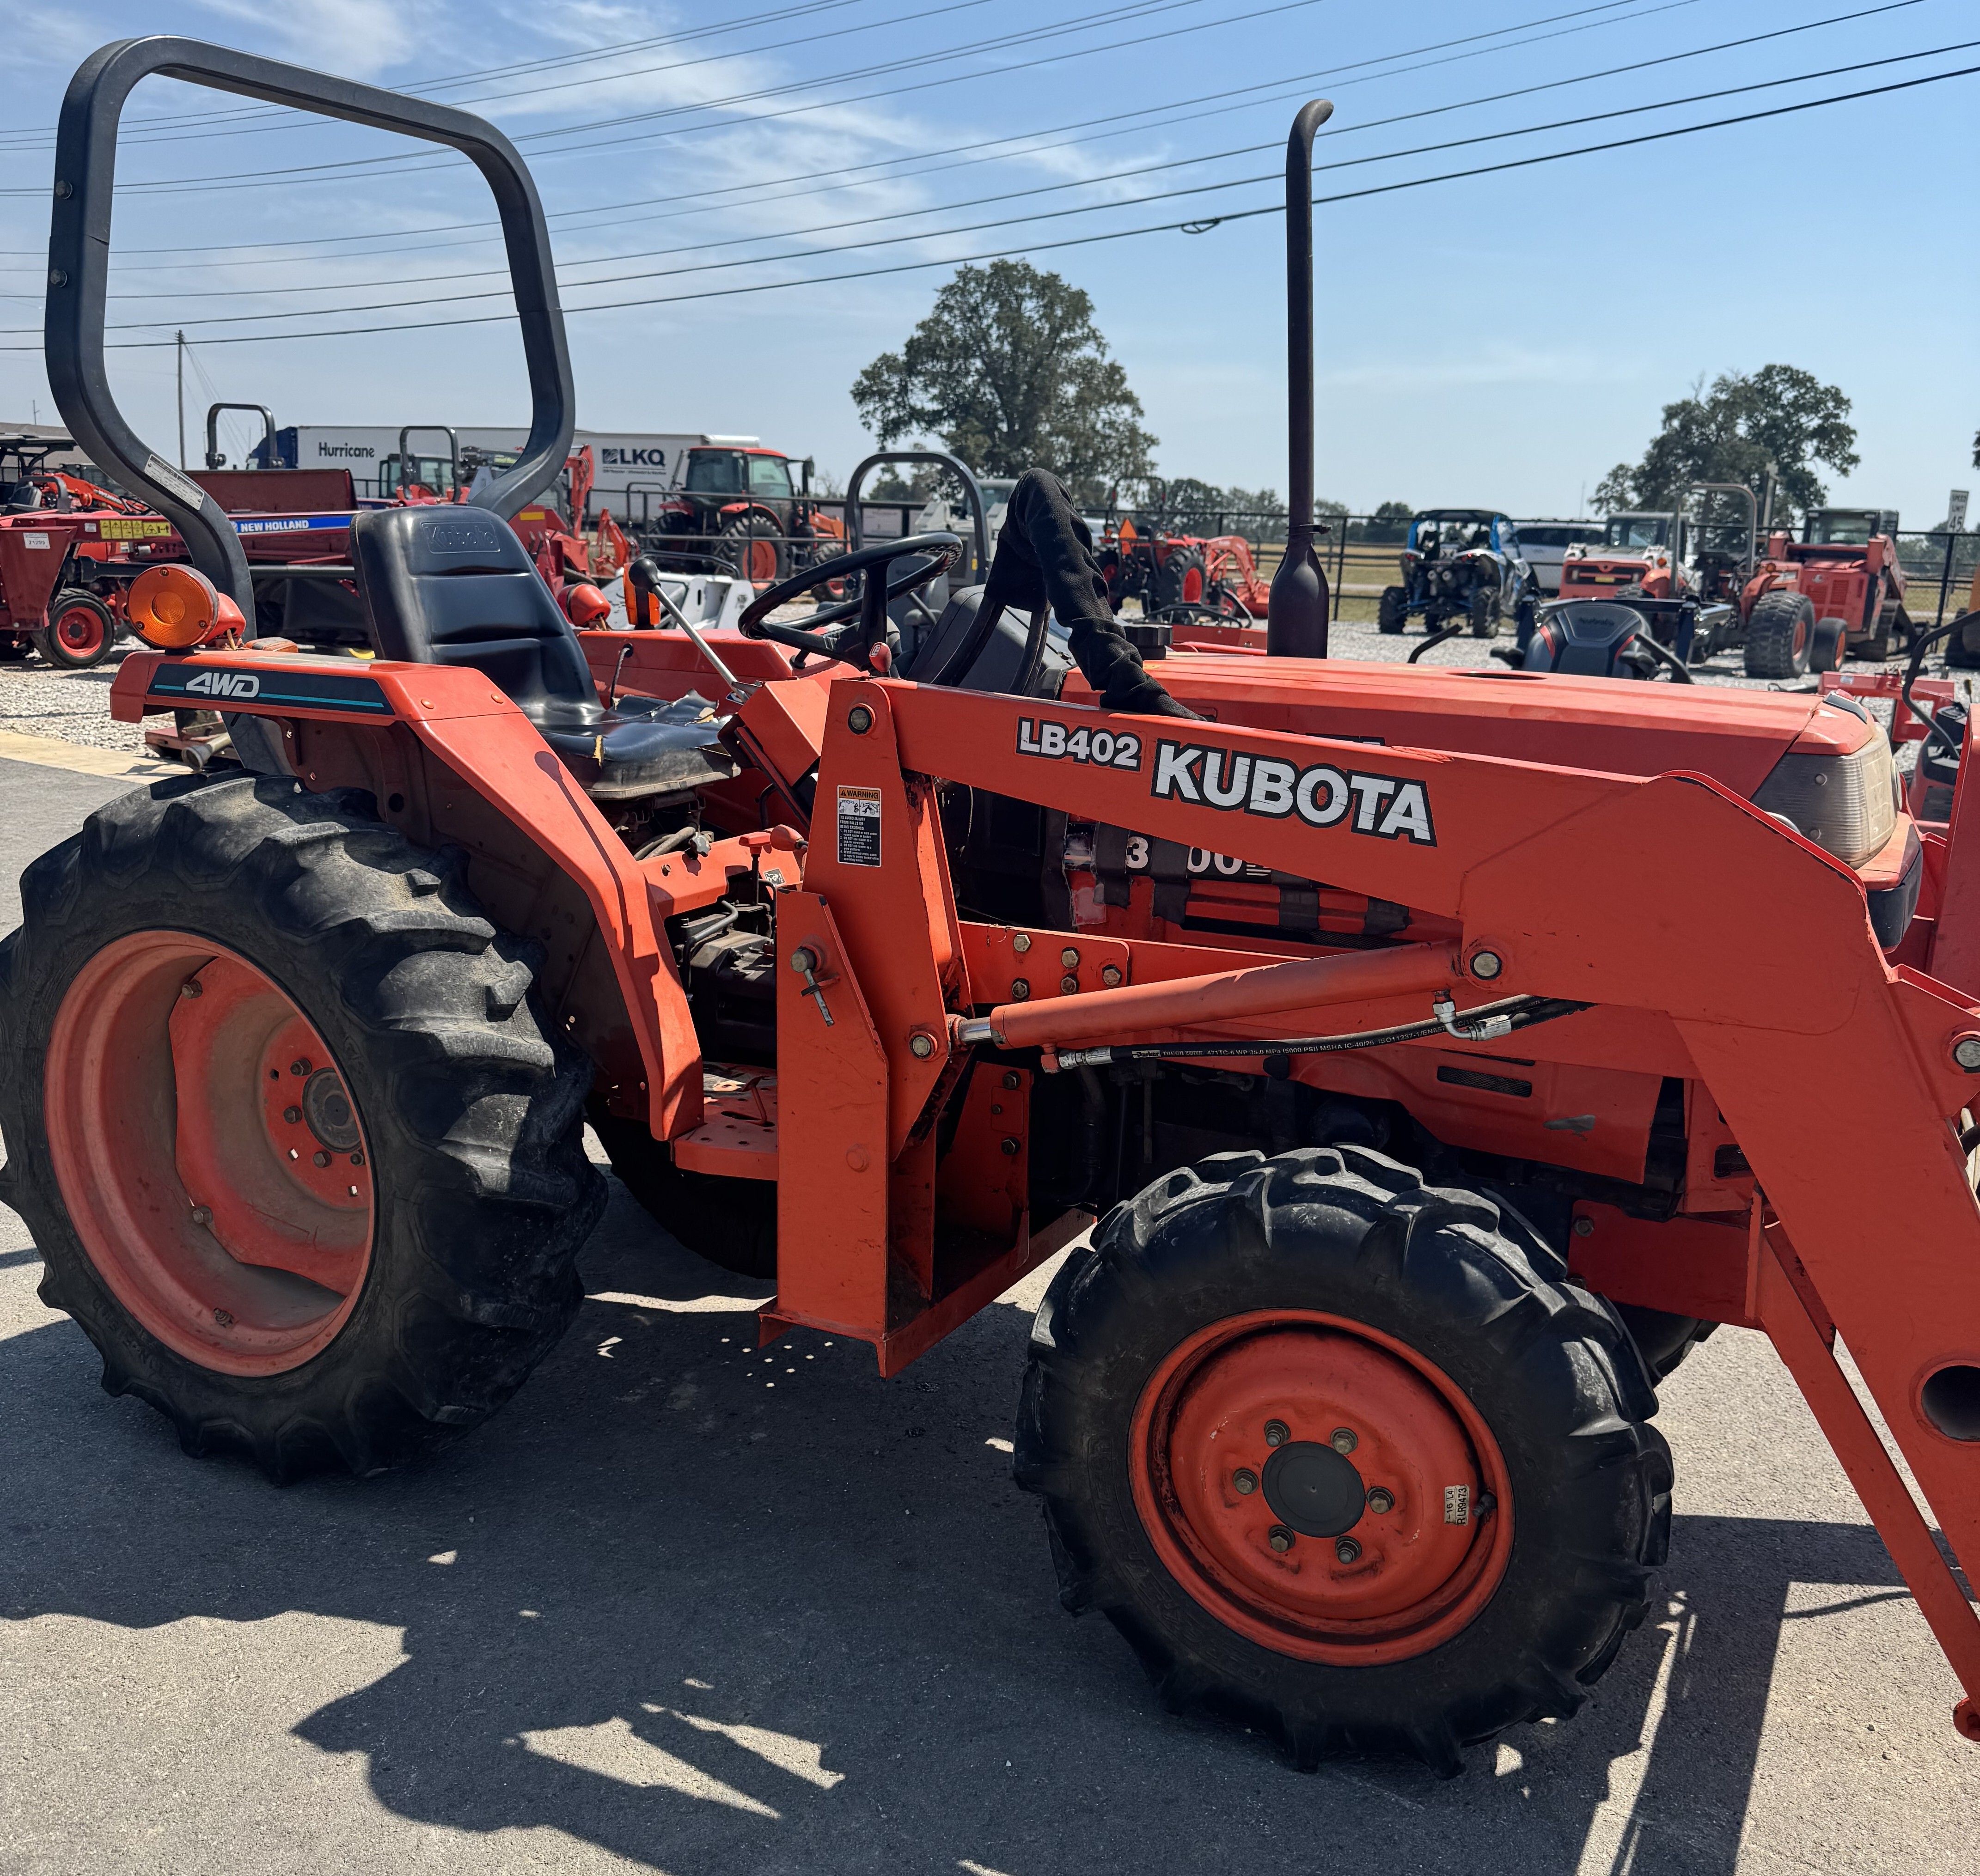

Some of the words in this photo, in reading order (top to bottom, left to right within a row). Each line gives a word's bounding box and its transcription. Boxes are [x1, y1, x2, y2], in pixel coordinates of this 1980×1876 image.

[319, 442, 375, 458] Hurricane
[620, 449, 665, 467] LKQ
[240, 522, 263, 532] NEW
[265, 520, 309, 531] HOLLAND
[1949, 516, 1963, 533] 45
[186, 672, 260, 698] 4WD
[1018, 719, 1140, 769] LB402
[847, 790, 878, 799] WARNING
[1154, 741, 1435, 843] KUBOTA
[1447, 1490, 1454, 1499] L4
